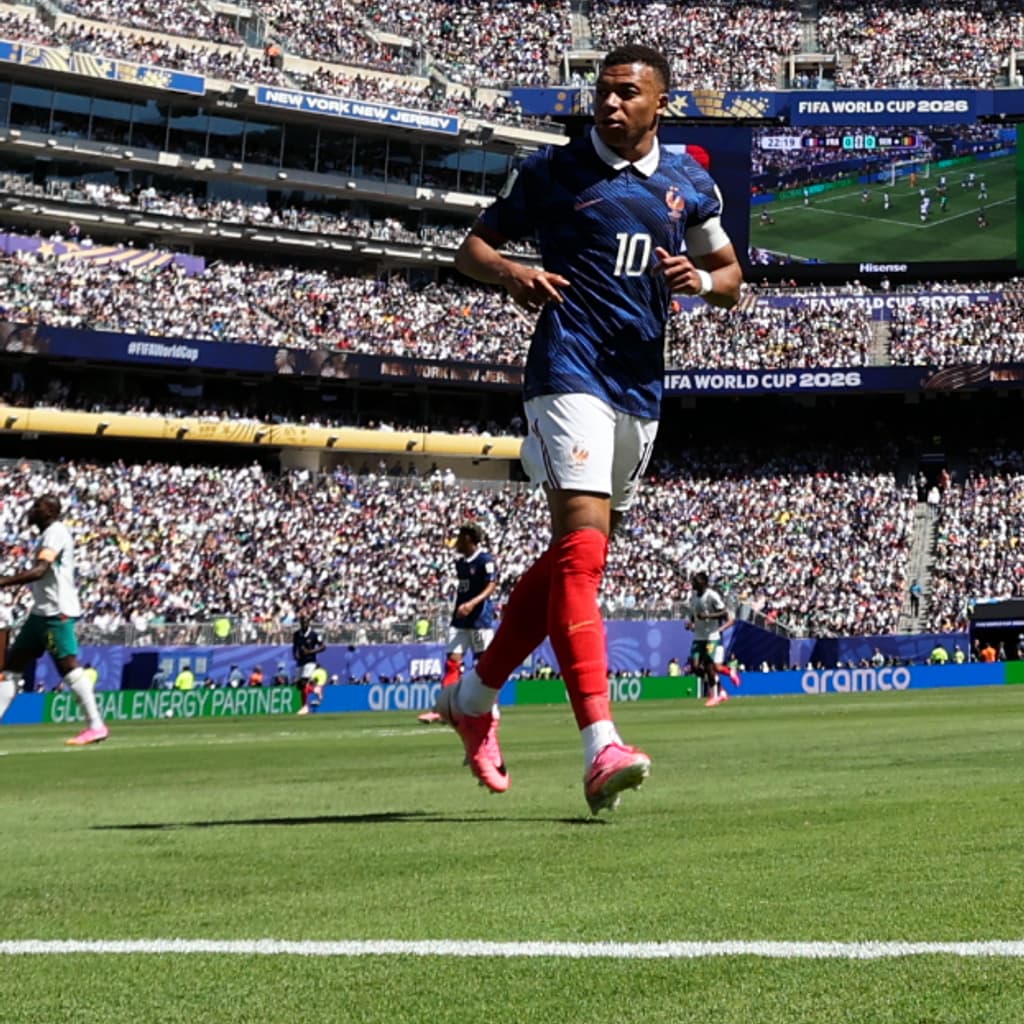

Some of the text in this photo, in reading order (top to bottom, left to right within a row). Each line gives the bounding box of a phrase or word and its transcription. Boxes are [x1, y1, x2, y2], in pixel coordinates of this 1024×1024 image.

[265, 90, 450, 129] NEW YORK NEW JERSEY
[798, 100, 968, 114] FIFA WORLD CUP 2026
[767, 138, 795, 147] 22:19
[613, 232, 651, 276] 10
[859, 263, 907, 273] Hisense
[127, 340, 199, 362] #FIFAWorldCup
[414, 363, 449, 379] YORK
[664, 372, 861, 389] IFA WORLD CUP 2026
[410, 659, 442, 675] FIFA
[802, 667, 911, 694] aramco
[51, 688, 293, 723] GLBAL ENERGY PARTNER
